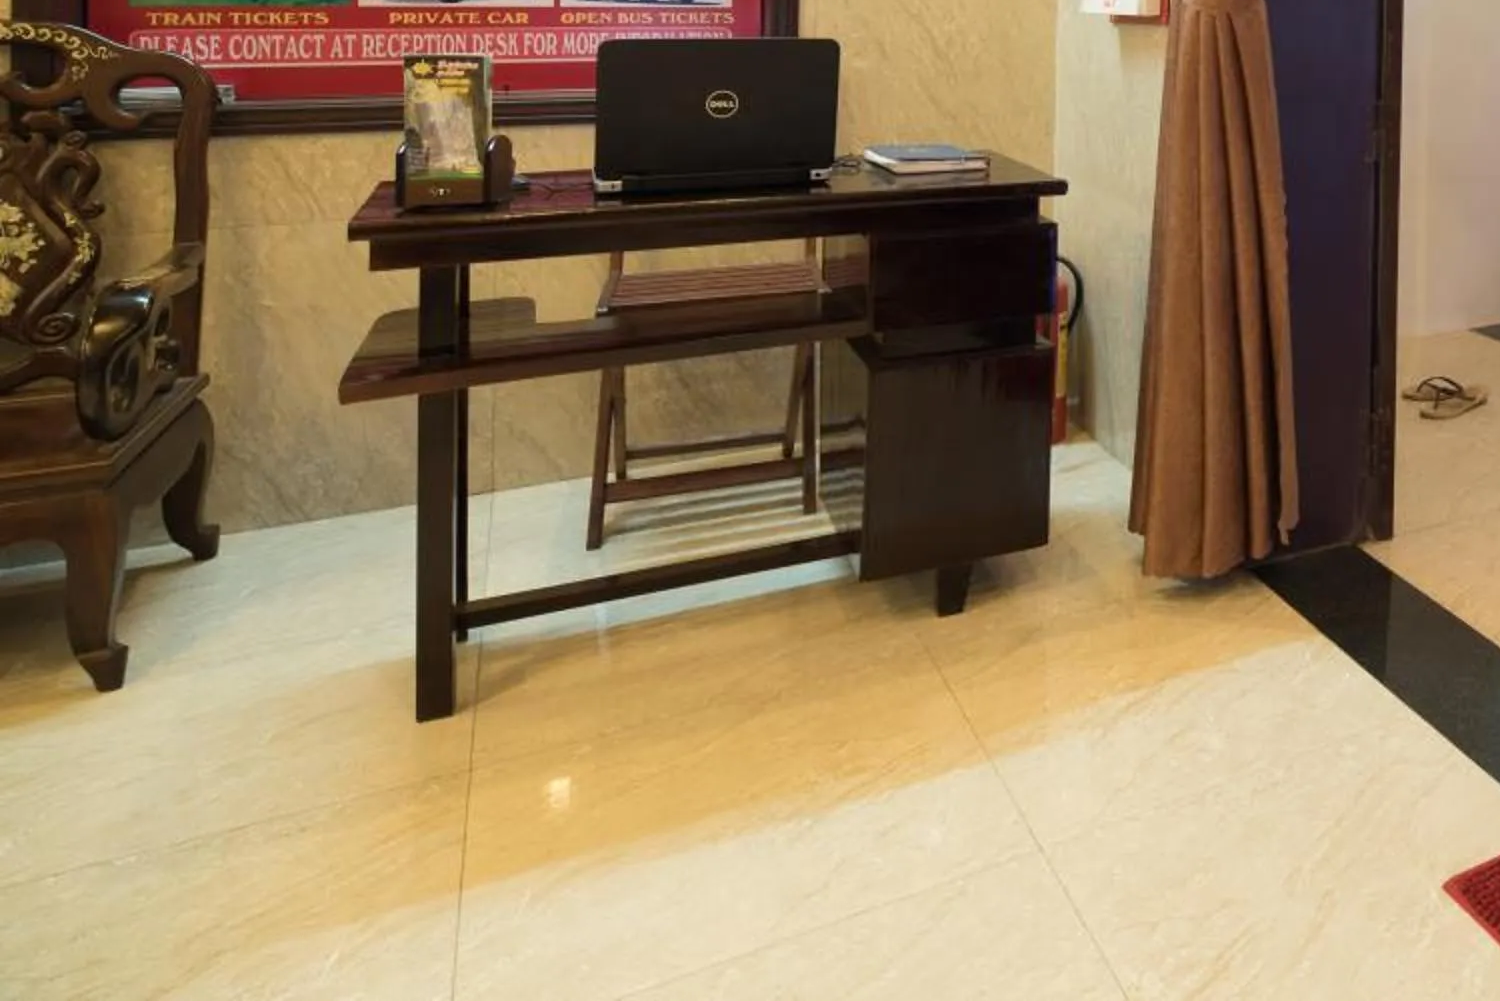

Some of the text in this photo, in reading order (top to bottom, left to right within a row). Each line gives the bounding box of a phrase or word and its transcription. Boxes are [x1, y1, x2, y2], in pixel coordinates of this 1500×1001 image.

[146, 11, 330, 26] TRAIN TICKETS
[388, 11, 530, 26] PRIVATE CAR
[559, 11, 735, 25] OPEN BUS TICKETS
[228, 33, 326, 61] CONTACT
[329, 33, 358, 59] AT
[361, 32, 467, 58] RECEPTION
[470, 32, 526, 56] DESK
[527, 32, 558, 56] FOR
[709, 100, 736, 109] DELL
